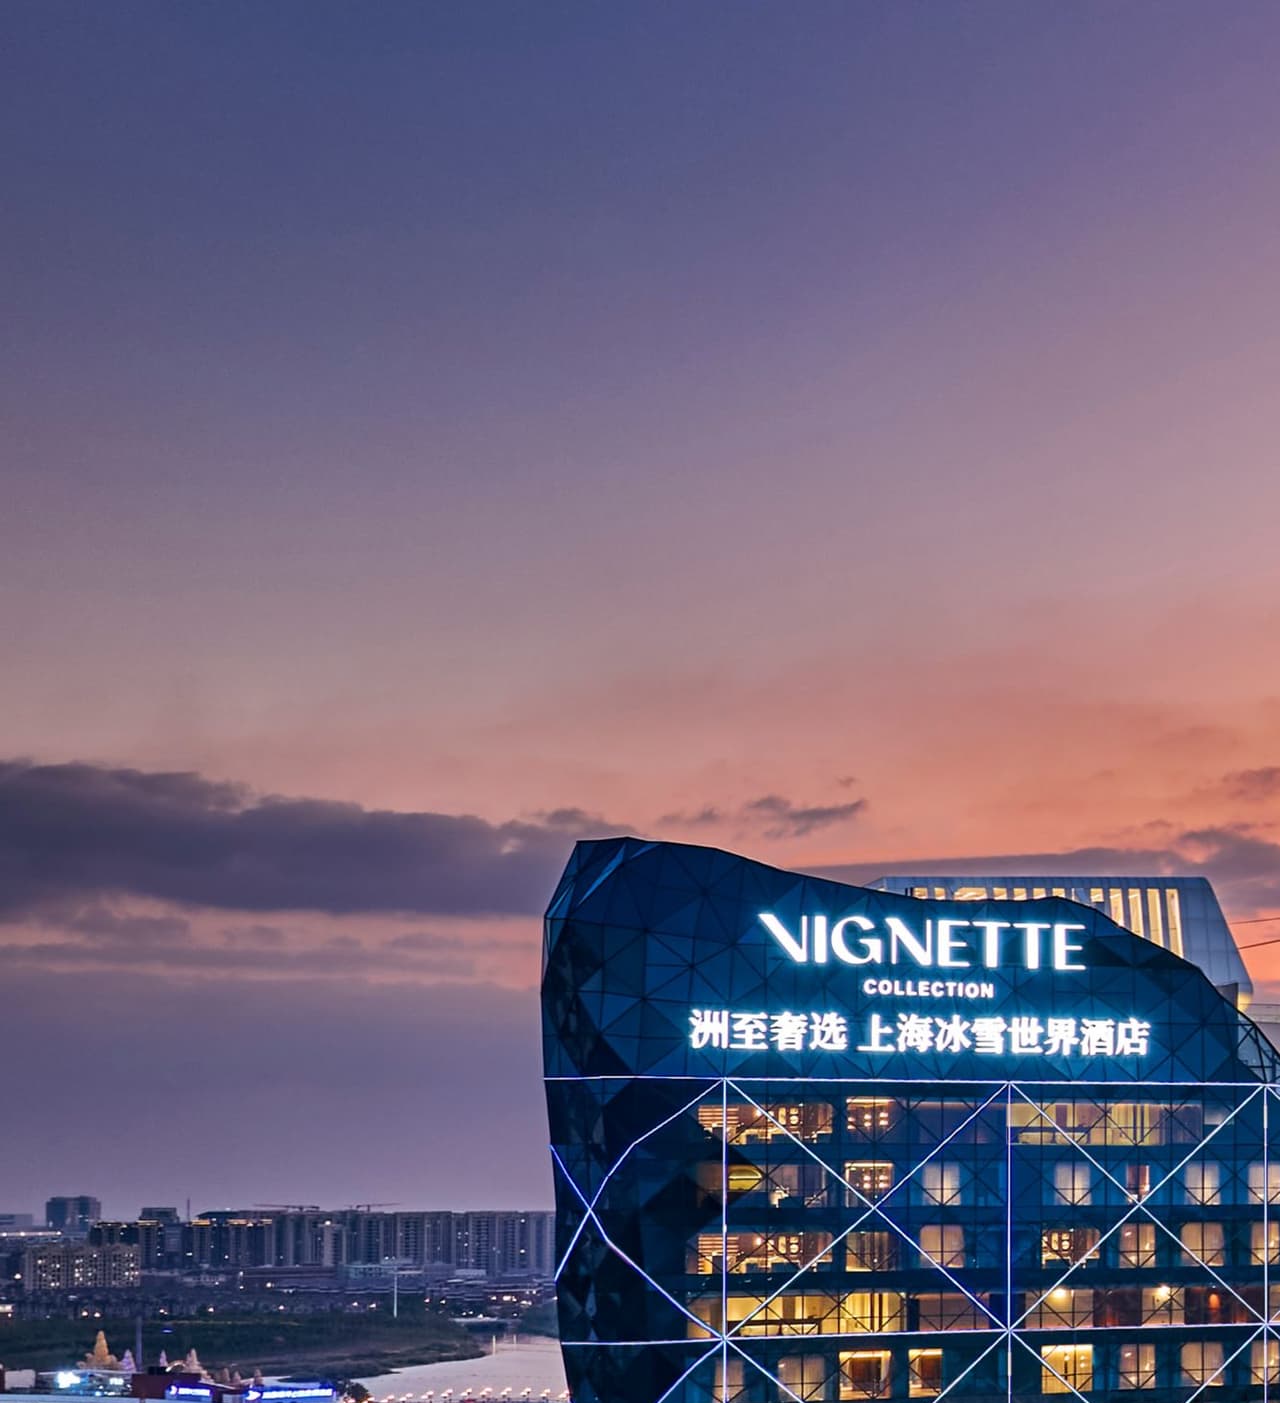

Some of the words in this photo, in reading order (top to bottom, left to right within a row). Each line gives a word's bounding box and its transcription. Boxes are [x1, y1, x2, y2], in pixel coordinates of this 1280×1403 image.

[759, 913, 1087, 971] VIGNETTE
[863, 978, 994, 998] COLLECTION
[689, 1009, 847, 1051] 洲至奢选
[857, 1013, 1151, 1056] 上海冰雪世界酒店
